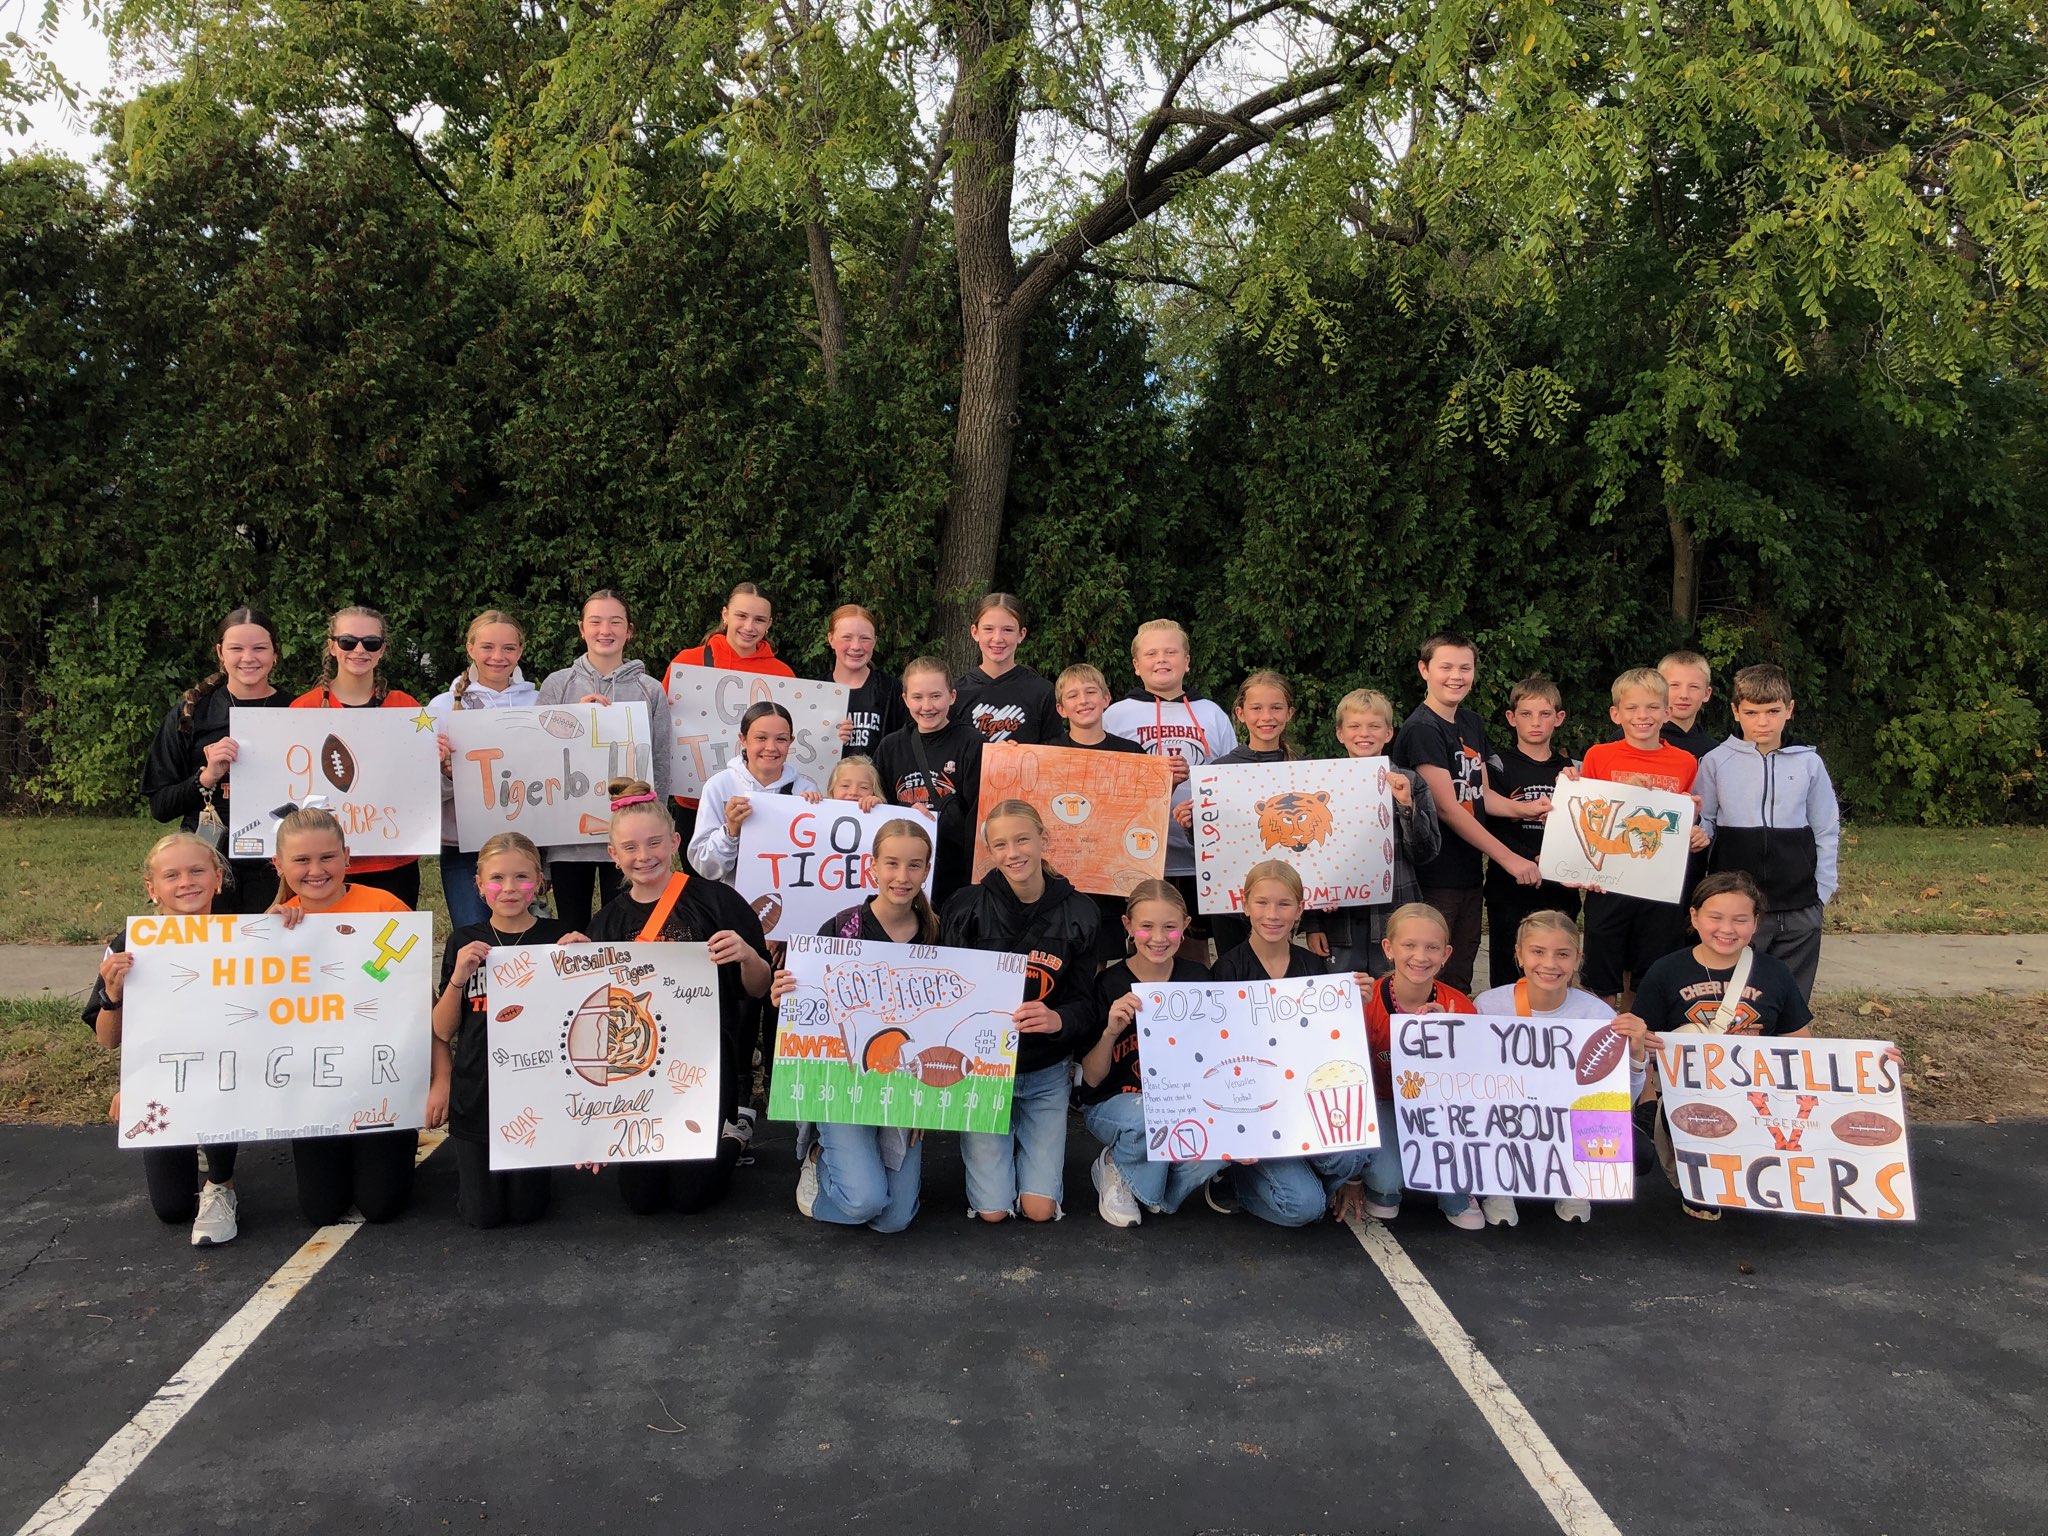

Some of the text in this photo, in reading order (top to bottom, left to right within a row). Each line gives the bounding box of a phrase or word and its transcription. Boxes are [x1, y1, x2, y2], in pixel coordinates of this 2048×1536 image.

[977, 713, 1021, 738] Tigers
[789, 812, 862, 854] GO
[1555, 860, 1625, 887] Go Tigers!
[130, 915, 237, 946] CAN'T
[550, 946, 632, 976] Versailles
[909, 944, 938, 959] 2025
[212, 955, 312, 986] HIDE
[493, 951, 537, 986] ROAR
[609, 963, 655, 985] Tigers
[663, 977, 676, 987] Go
[673, 986, 713, 1004] tigers
[837, 970, 868, 1009] GO
[1149, 988, 1227, 1023] 2025
[1679, 981, 1722, 1001] CHEER
[269, 993, 345, 1025] OUR
[781, 998, 830, 1026] #28
[492, 1048, 554, 1069] GO TIGERS!
[1399, 1019, 1576, 1070] GET YOUR
[159, 1044, 400, 1093] TIGER
[667, 1060, 707, 1088] ROAR
[1656, 1044, 1896, 1094] VERSAILLES
[565, 1089, 655, 1125] Tigerball
[880, 1086, 894, 1104] 50
[349, 1098, 400, 1132] pride
[500, 1106, 543, 1144] ROAR
[1401, 1103, 1569, 1143] WE'RE ABOUT
[608, 1117, 665, 1157] 2025
[1403, 1140, 1633, 1200] 2 PUT ON A SHOW
[1676, 1147, 1906, 1219] TIGERS
